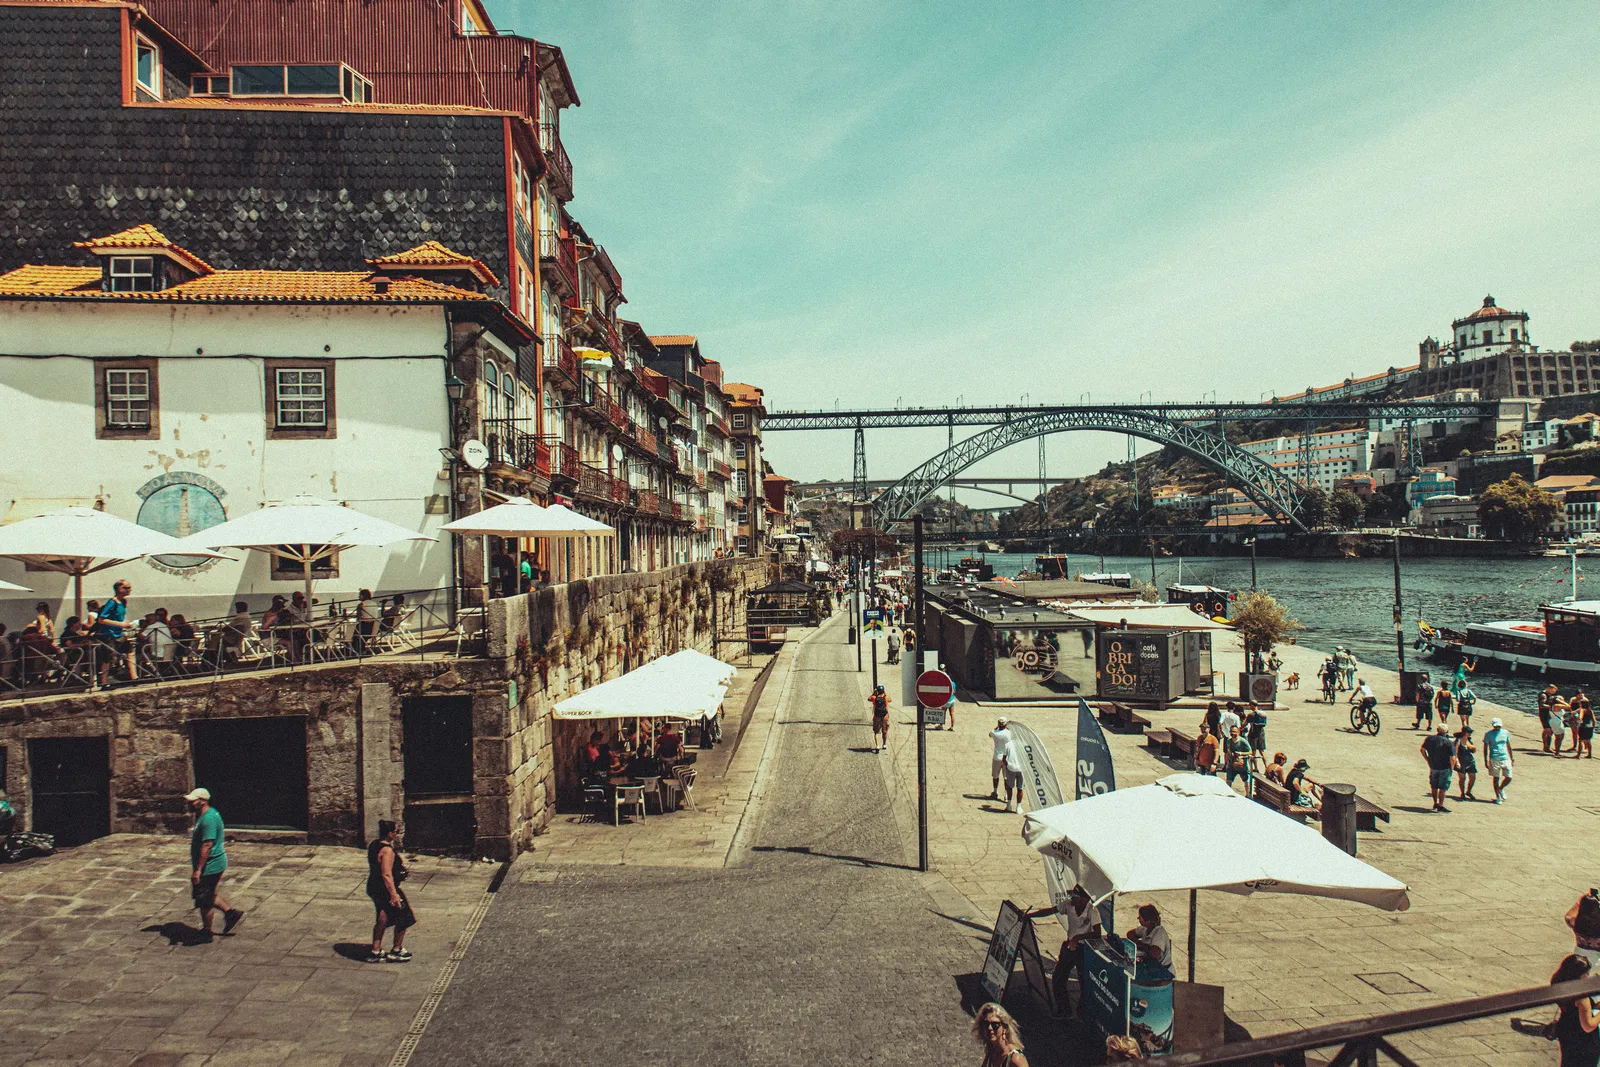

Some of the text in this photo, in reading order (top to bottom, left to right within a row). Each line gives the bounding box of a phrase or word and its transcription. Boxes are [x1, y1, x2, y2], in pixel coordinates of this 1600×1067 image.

[1111, 641, 1122, 653] O
[1142, 643, 1156, 652] café
[1015, 650, 1039, 671] 30
[1108, 652, 1132, 664] BRI
[1105, 663, 1127, 675] GA
[1111, 674, 1137, 686] DO!
[1051, 840, 1073, 860] CRUZ
